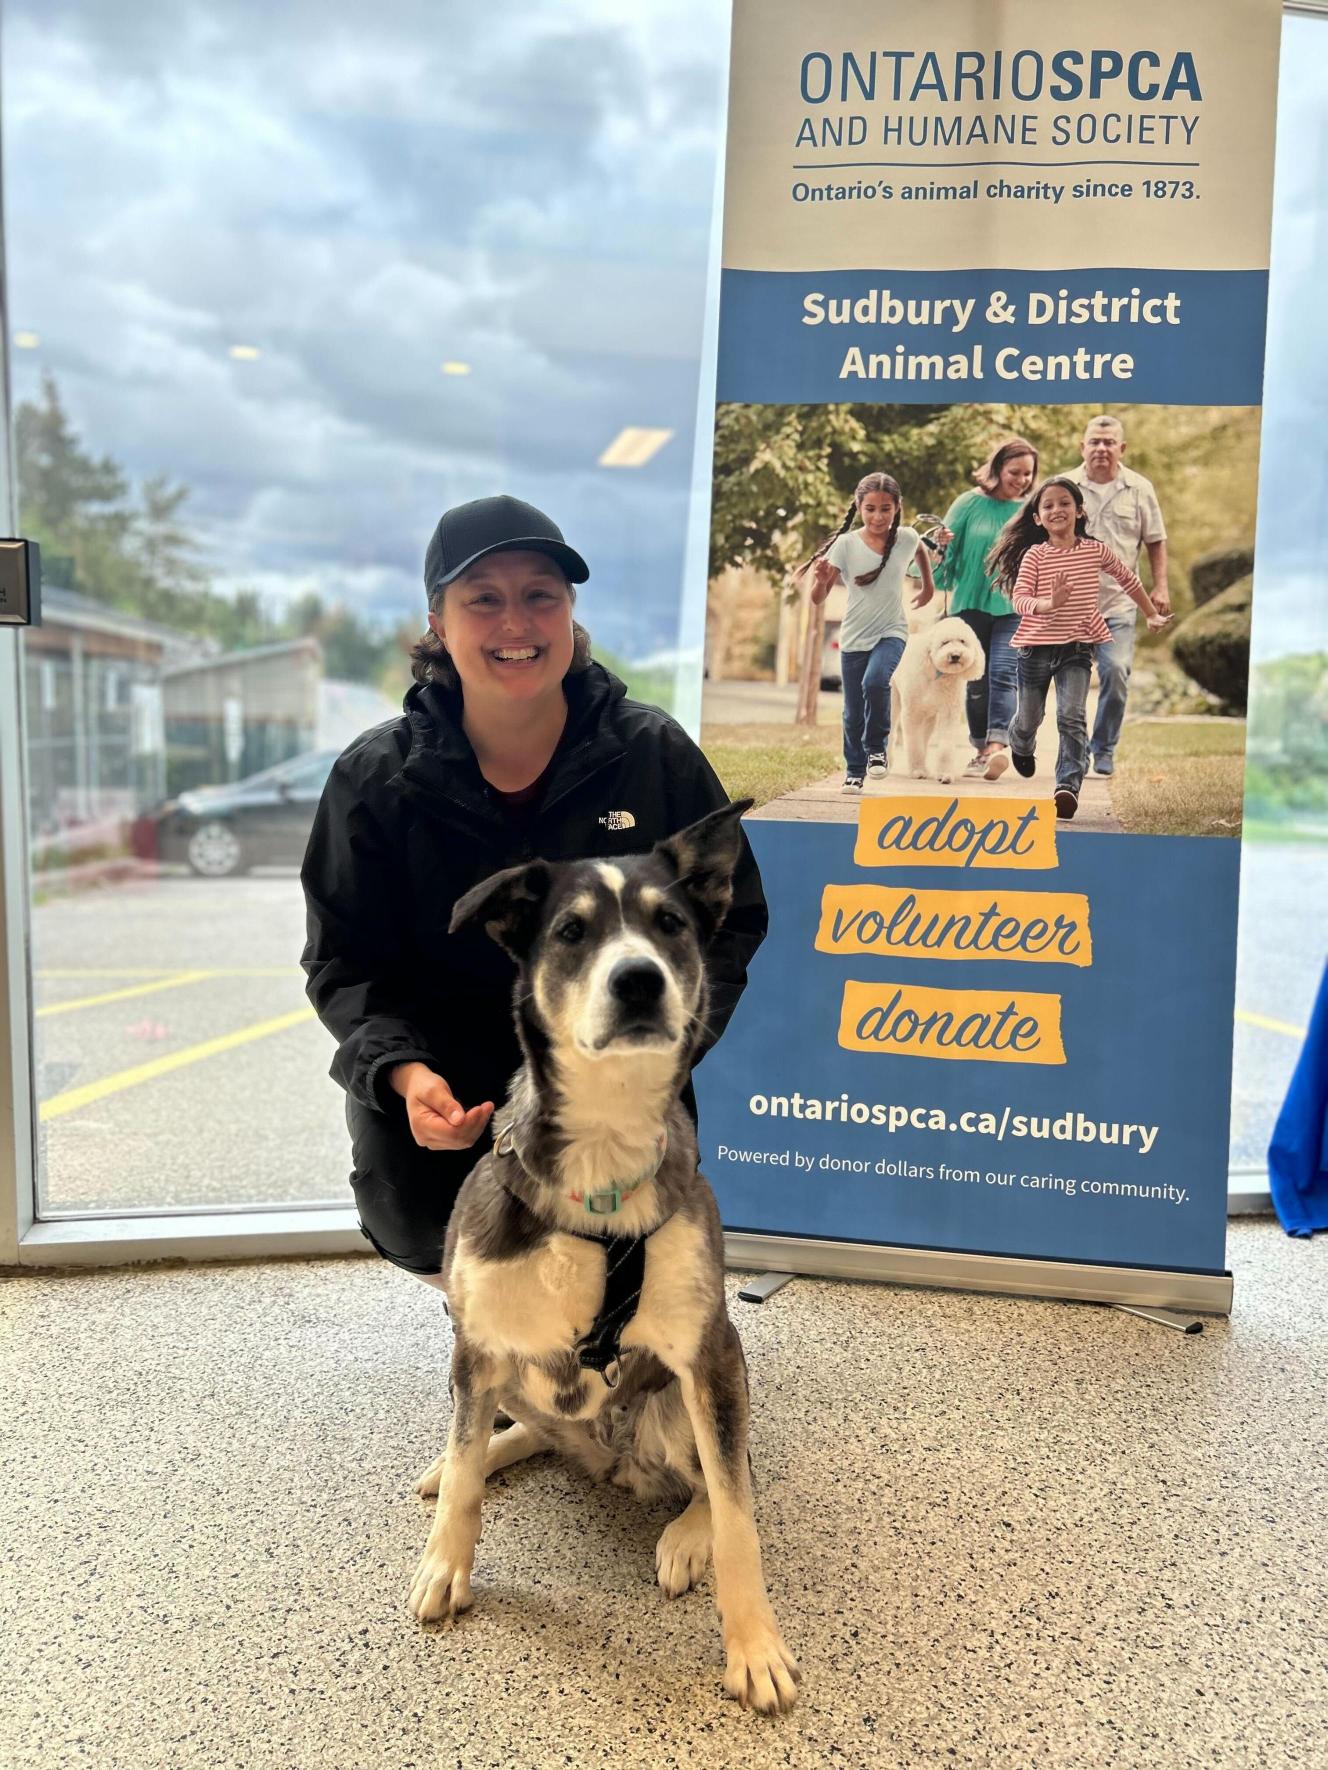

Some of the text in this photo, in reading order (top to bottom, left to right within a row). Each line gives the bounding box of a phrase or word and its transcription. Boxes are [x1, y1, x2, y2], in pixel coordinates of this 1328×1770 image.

[800, 49, 1203, 104] ONTARIOSPCA
[795, 113, 1200, 148] AND HUMANE SOCIETY
[792, 179, 1201, 205] Ontario’s animal charity since 1873.
[801, 288, 1181, 333] Sudbury & District
[838, 345, 1135, 381] Animal Centre
[876, 798, 1039, 868] adopt
[831, 894, 1081, 956] volunteer
[855, 989, 1042, 1052] donate
[748, 1091, 1159, 1154] ontariospca.ca/sudbury
[717, 1145, 1191, 1203] Powered by donor dollars from our caring community.
